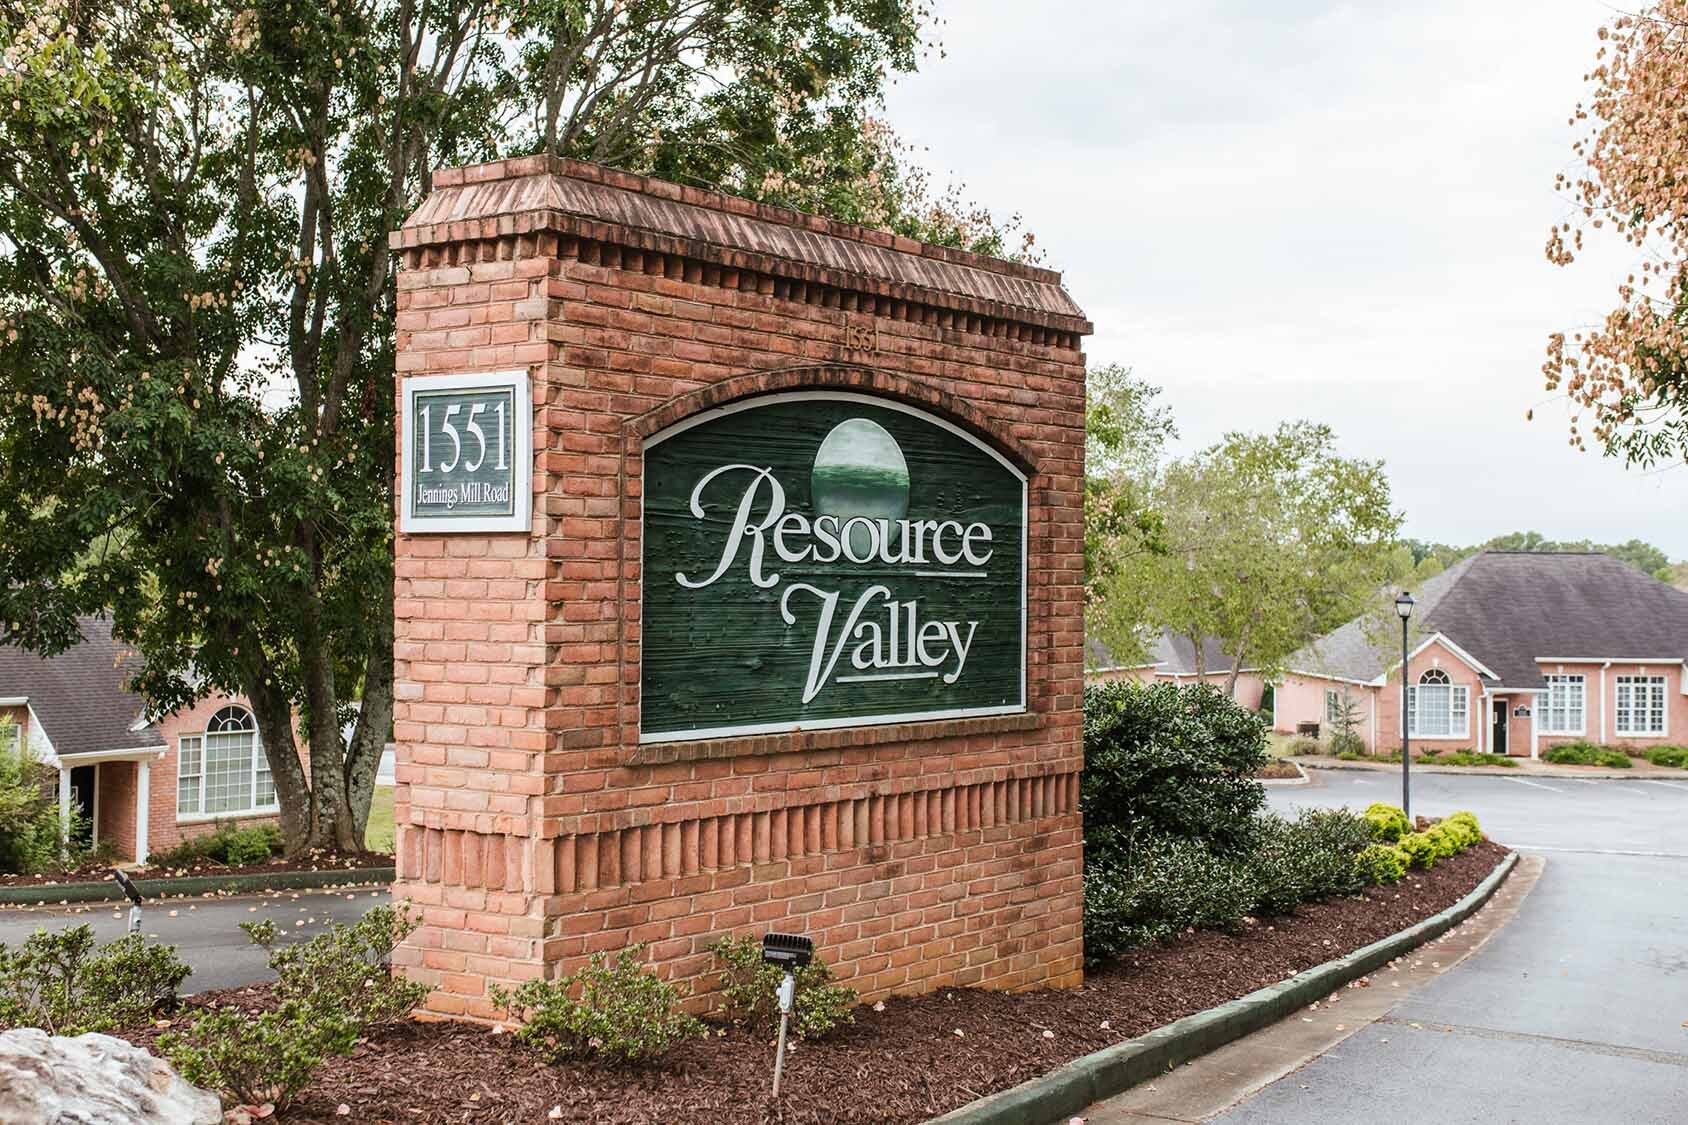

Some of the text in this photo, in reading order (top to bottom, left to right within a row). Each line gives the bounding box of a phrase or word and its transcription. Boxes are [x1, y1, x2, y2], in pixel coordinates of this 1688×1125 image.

[419, 401, 509, 473] 1551
[417, 481, 509, 509] Jennings Mill Road
[675, 464, 994, 588] Resource
[781, 583, 979, 704] Valley
